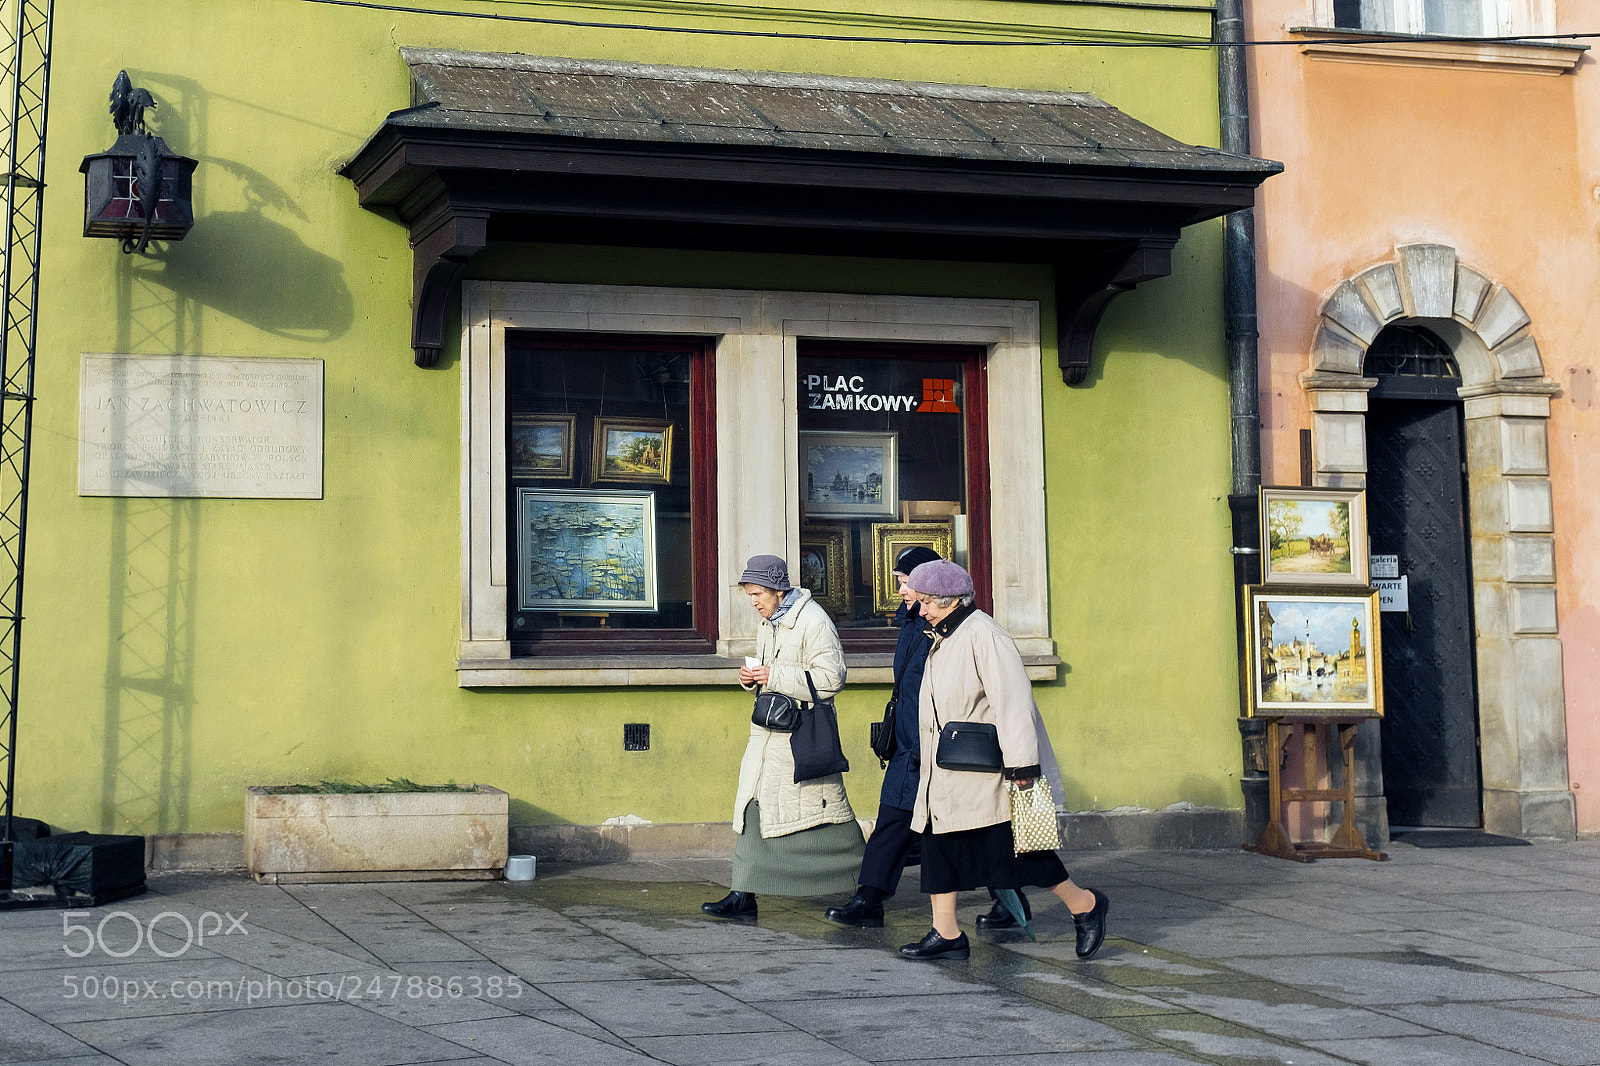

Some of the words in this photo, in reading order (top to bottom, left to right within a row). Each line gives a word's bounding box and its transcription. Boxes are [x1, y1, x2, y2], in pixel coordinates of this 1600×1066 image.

[808, 375, 864, 392] PLAC
[96, 396, 130, 410] JAN
[141, 397, 308, 413] ZACHWATOWICZ
[808, 393, 914, 411] ZAMKOWY
[250, 445, 307, 454] ODBUDOWY
